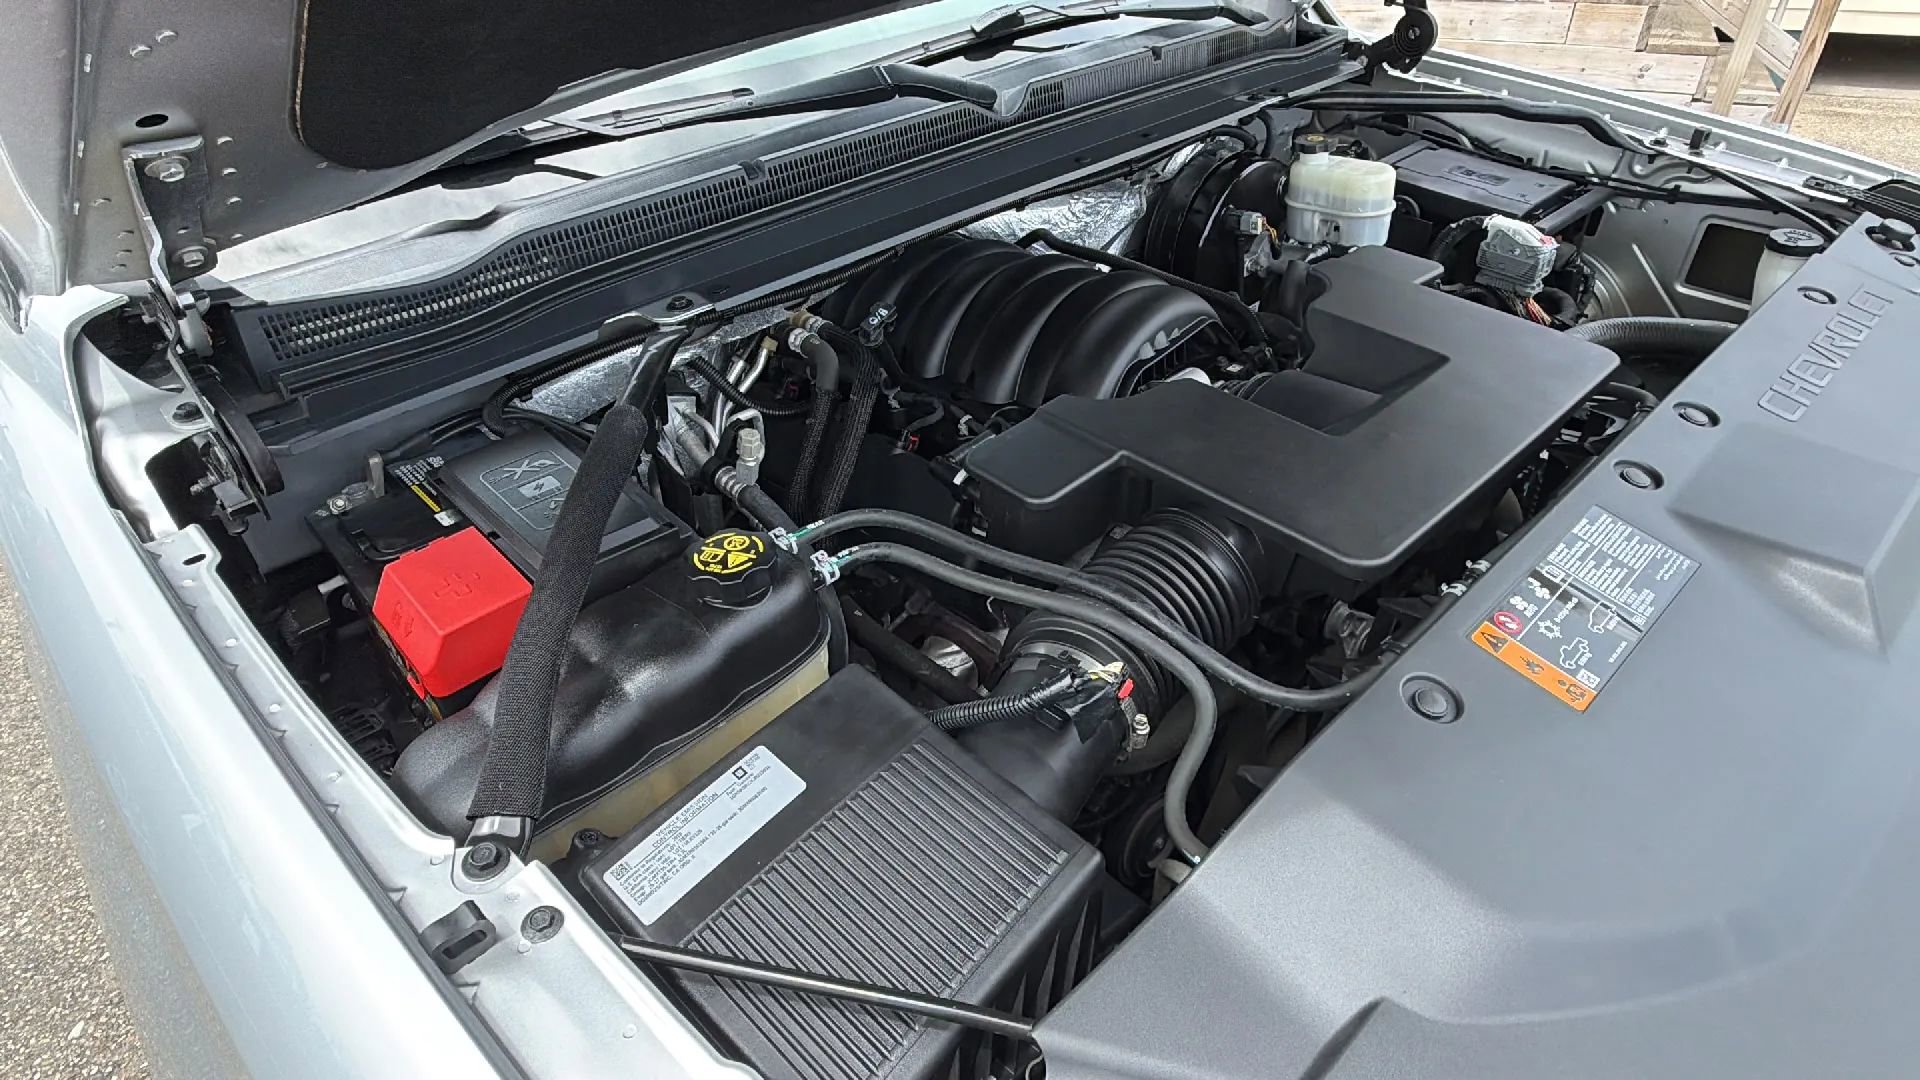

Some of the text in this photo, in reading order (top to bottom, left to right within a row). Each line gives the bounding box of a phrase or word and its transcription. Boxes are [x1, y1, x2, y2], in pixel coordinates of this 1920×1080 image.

[1757, 283, 1893, 422] CHEVROLET
[651, 822, 681, 848] CONTROL
[678, 791, 718, 825] INFORMATION
[655, 815, 681, 837] VEHICLE
[679, 793, 708, 817] EMISSION
